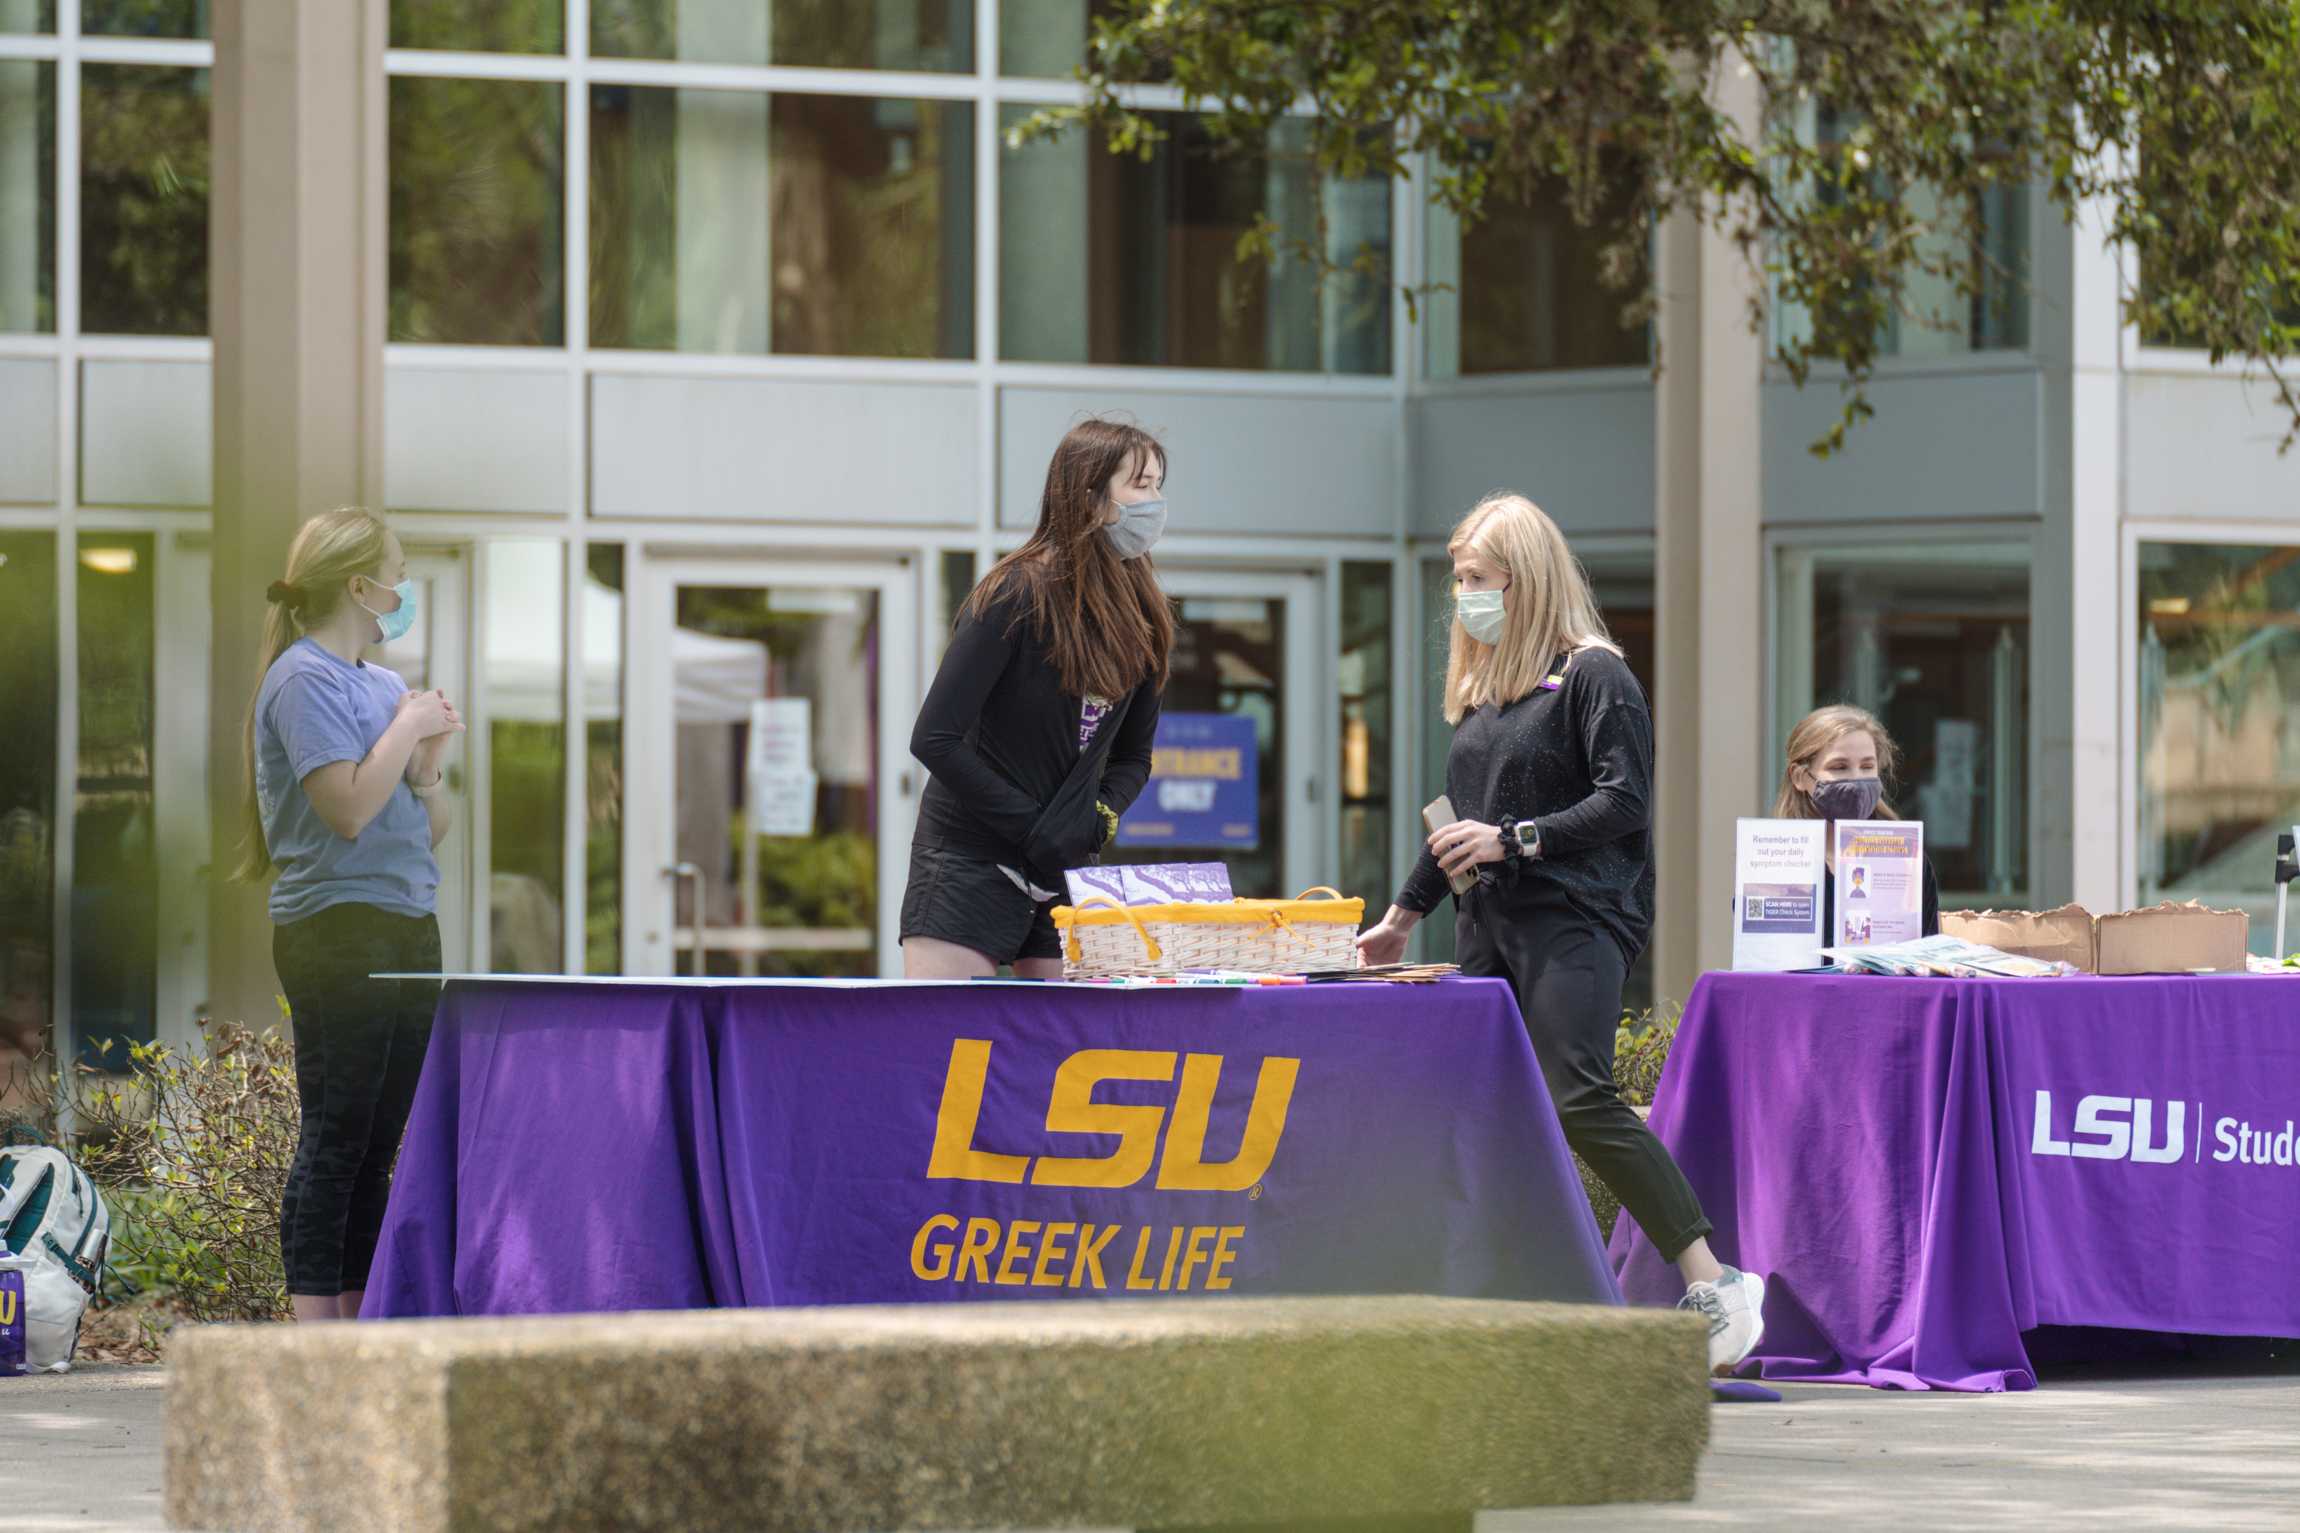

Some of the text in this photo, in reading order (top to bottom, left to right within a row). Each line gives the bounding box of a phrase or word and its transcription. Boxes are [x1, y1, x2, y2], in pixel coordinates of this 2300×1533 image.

[927, 1039, 1301, 1191] LSU
[2031, 1090, 2186, 1164] LSU
[910, 1214, 1246, 1291] GREEK LIFE
